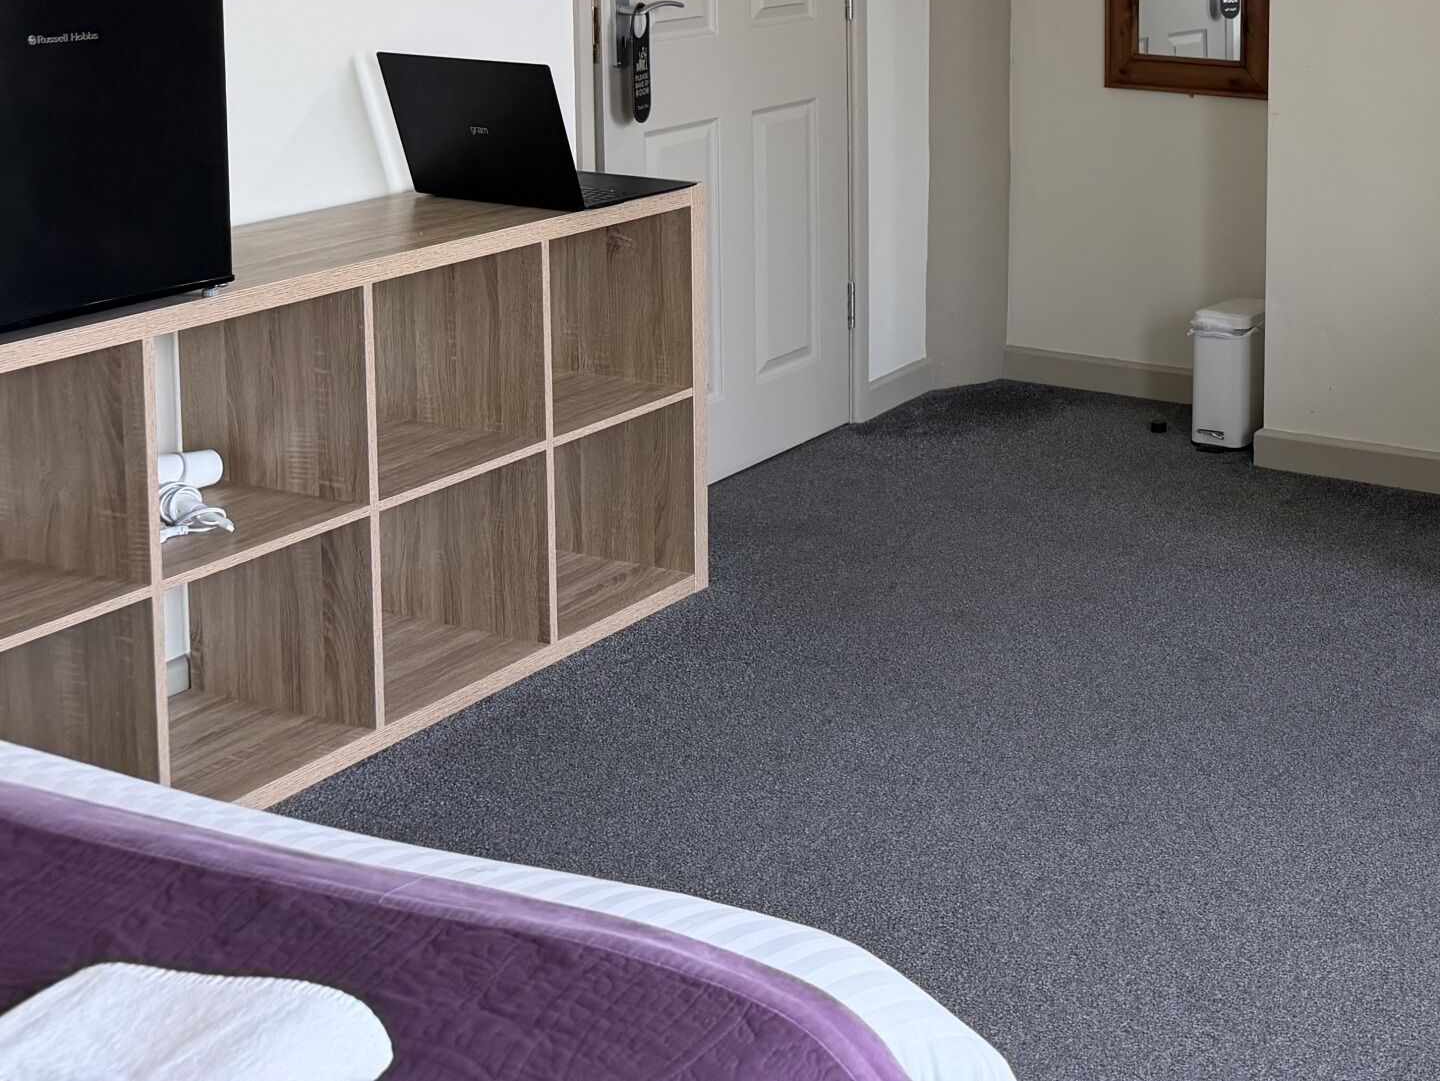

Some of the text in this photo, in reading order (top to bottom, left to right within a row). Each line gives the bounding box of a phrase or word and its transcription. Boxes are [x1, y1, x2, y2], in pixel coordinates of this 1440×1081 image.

[37, 32, 98, 44] Russell Hobbs
[470, 126, 488, 135] gram
